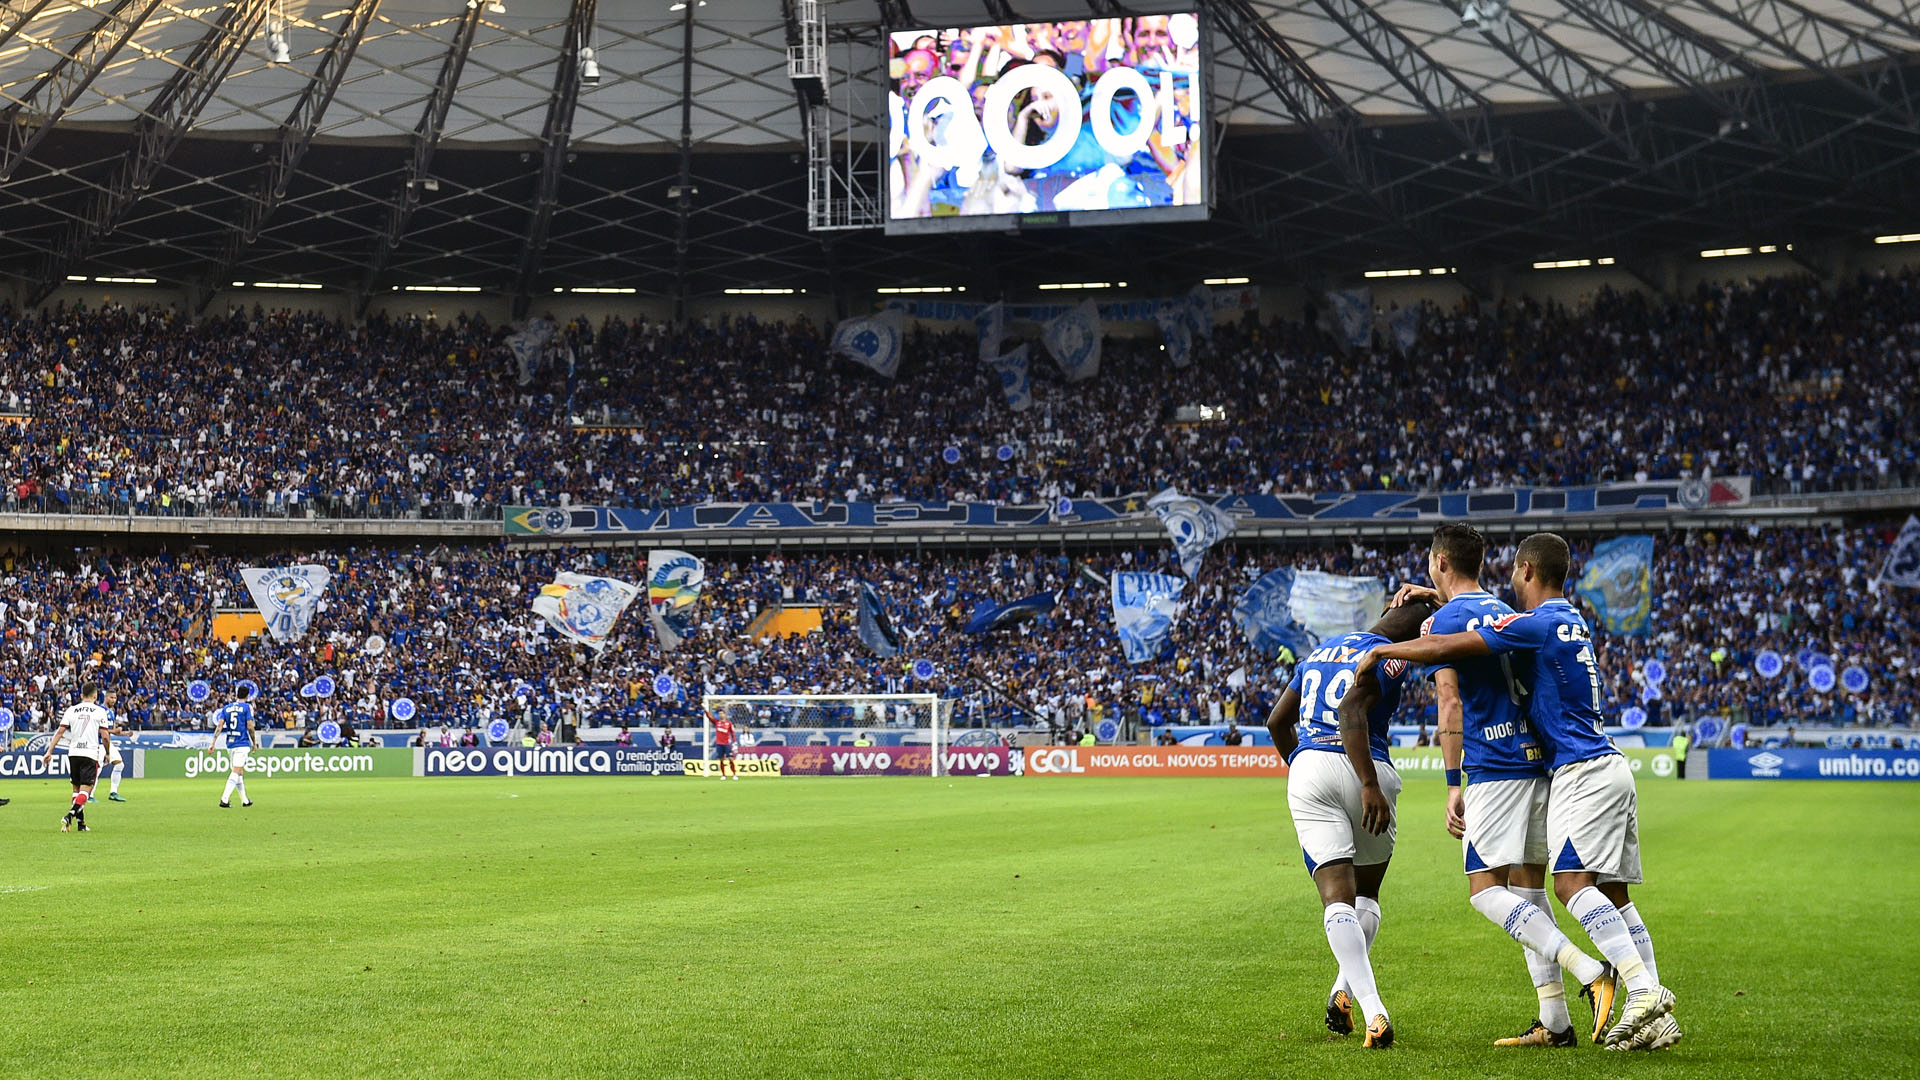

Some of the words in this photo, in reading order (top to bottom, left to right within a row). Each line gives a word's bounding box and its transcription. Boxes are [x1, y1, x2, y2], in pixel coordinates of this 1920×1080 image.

[78, 714, 91, 738] 7
[230, 711, 238, 730] 5
[1484, 721, 1516, 741] DIOG
[185, 751, 373, 778] globesporte.com
[427, 750, 490, 773] neo
[493, 746, 611, 777] química
[615, 751, 625, 761] O
[1030, 749, 1085, 773] GOL
[1090, 754, 1130, 768] NOVA
[1132, 754, 1164, 768] GOL.
[1167, 754, 1217, 768] NOVOS
[1220, 754, 1278, 768] TEMPOS
[1818, 753, 1920, 776] umbro.co
